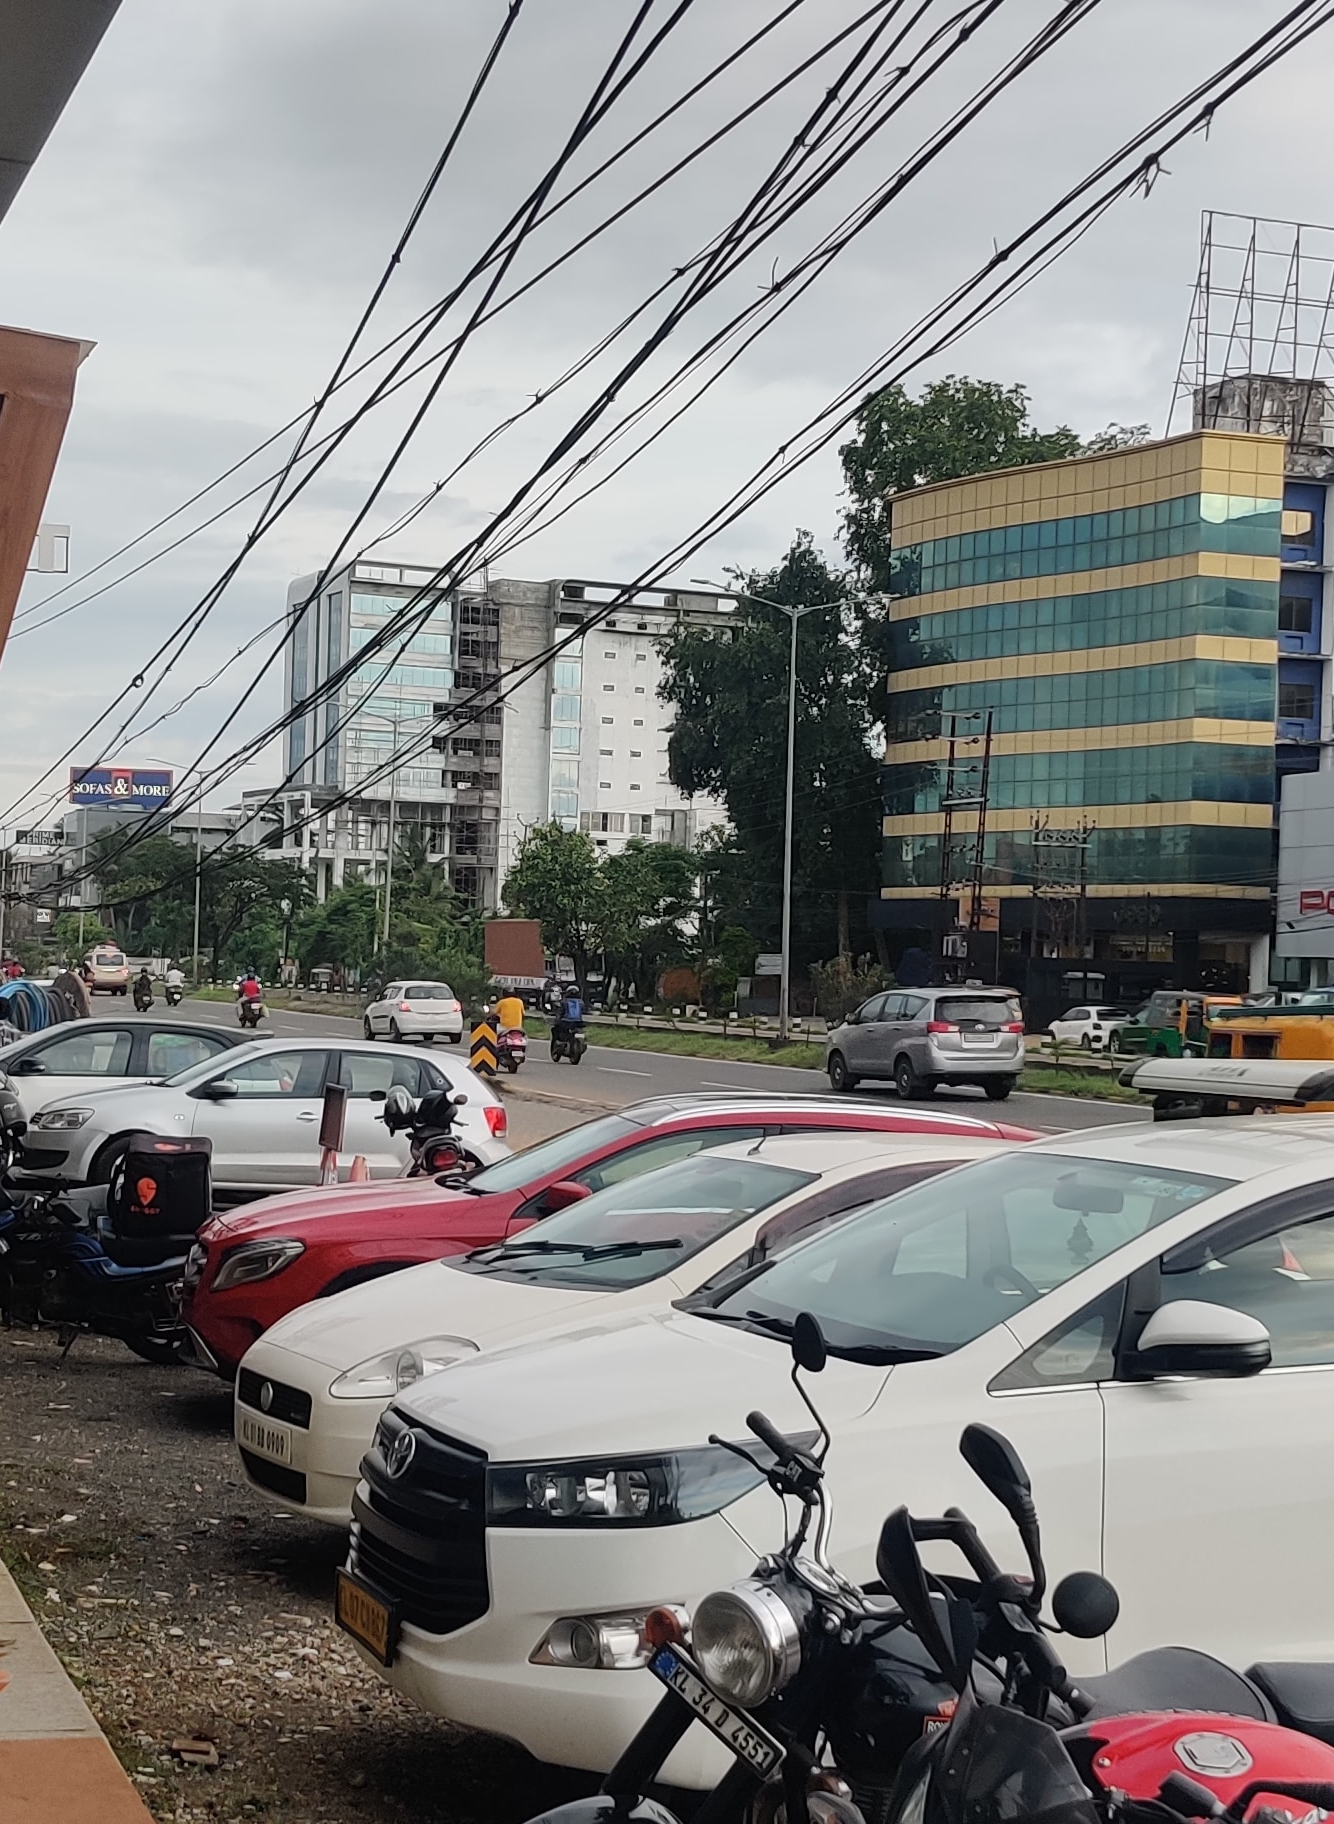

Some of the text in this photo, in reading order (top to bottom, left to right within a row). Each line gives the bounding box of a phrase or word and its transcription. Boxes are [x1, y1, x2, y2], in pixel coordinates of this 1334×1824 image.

[72, 778, 170, 798] SOFAS & MORE
[669, 1667, 770, 1769] KL 34 D 4551
